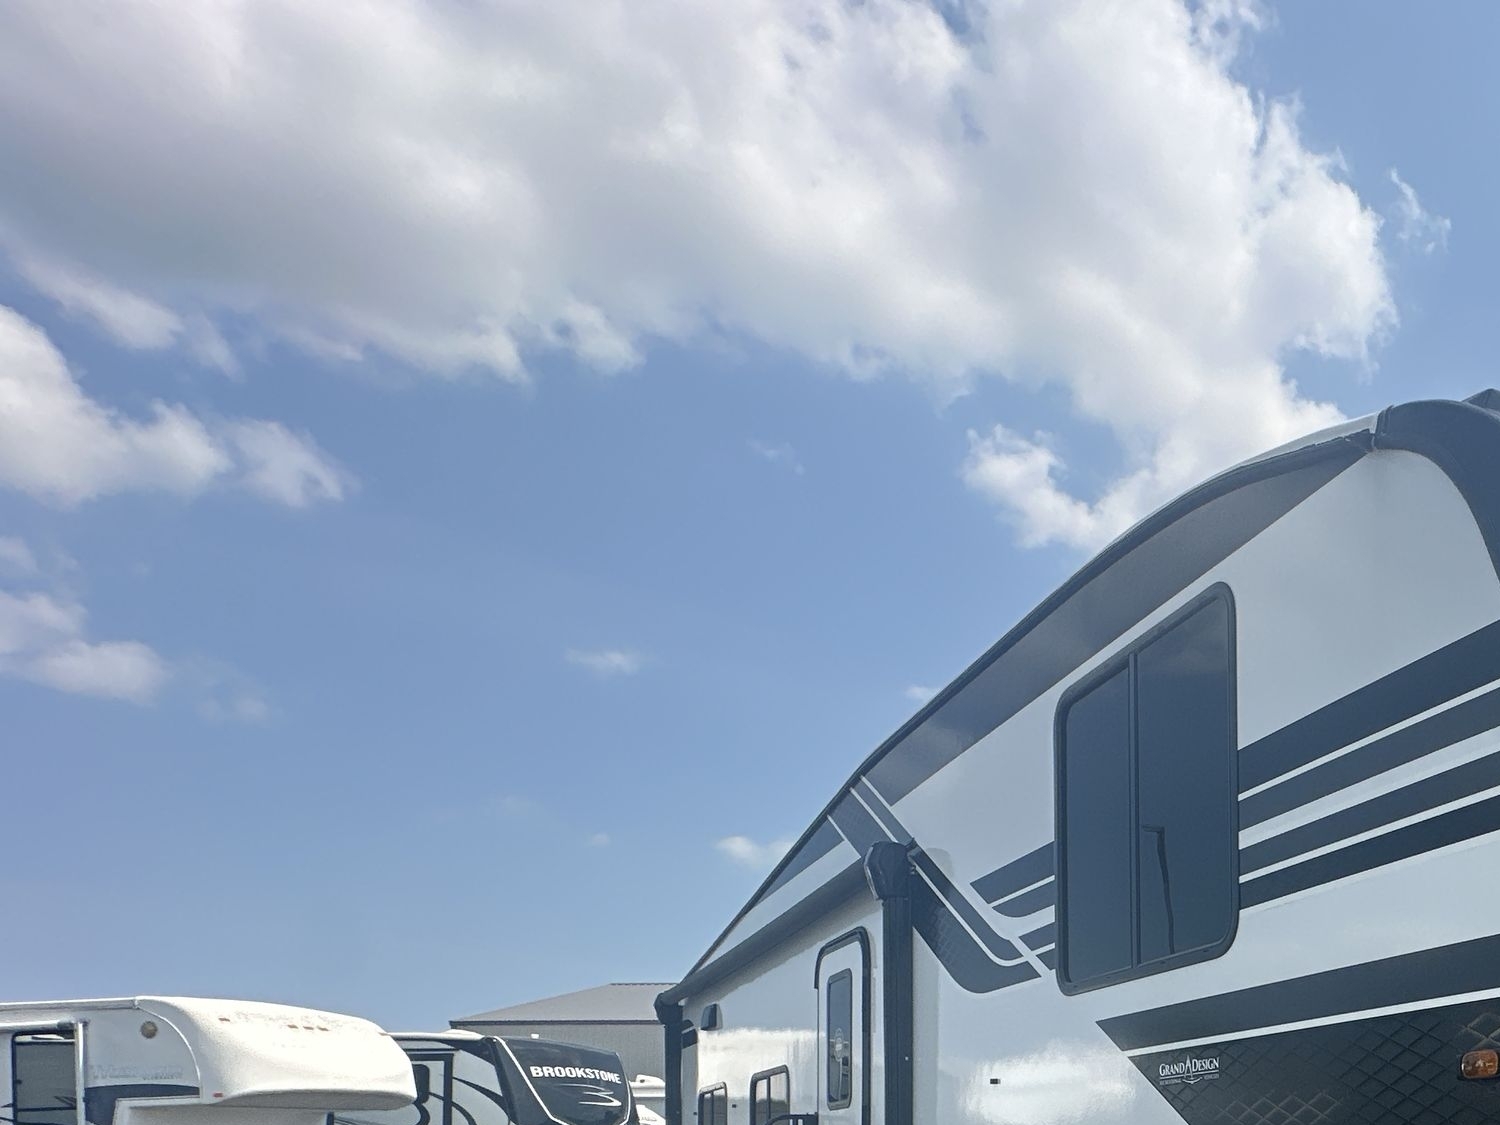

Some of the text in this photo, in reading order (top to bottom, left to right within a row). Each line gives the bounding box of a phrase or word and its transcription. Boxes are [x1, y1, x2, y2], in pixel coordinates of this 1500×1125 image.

[529, 1066, 622, 1084] BROOKSTONE
[1159, 1057, 1219, 1076] GRAND DESIGN
